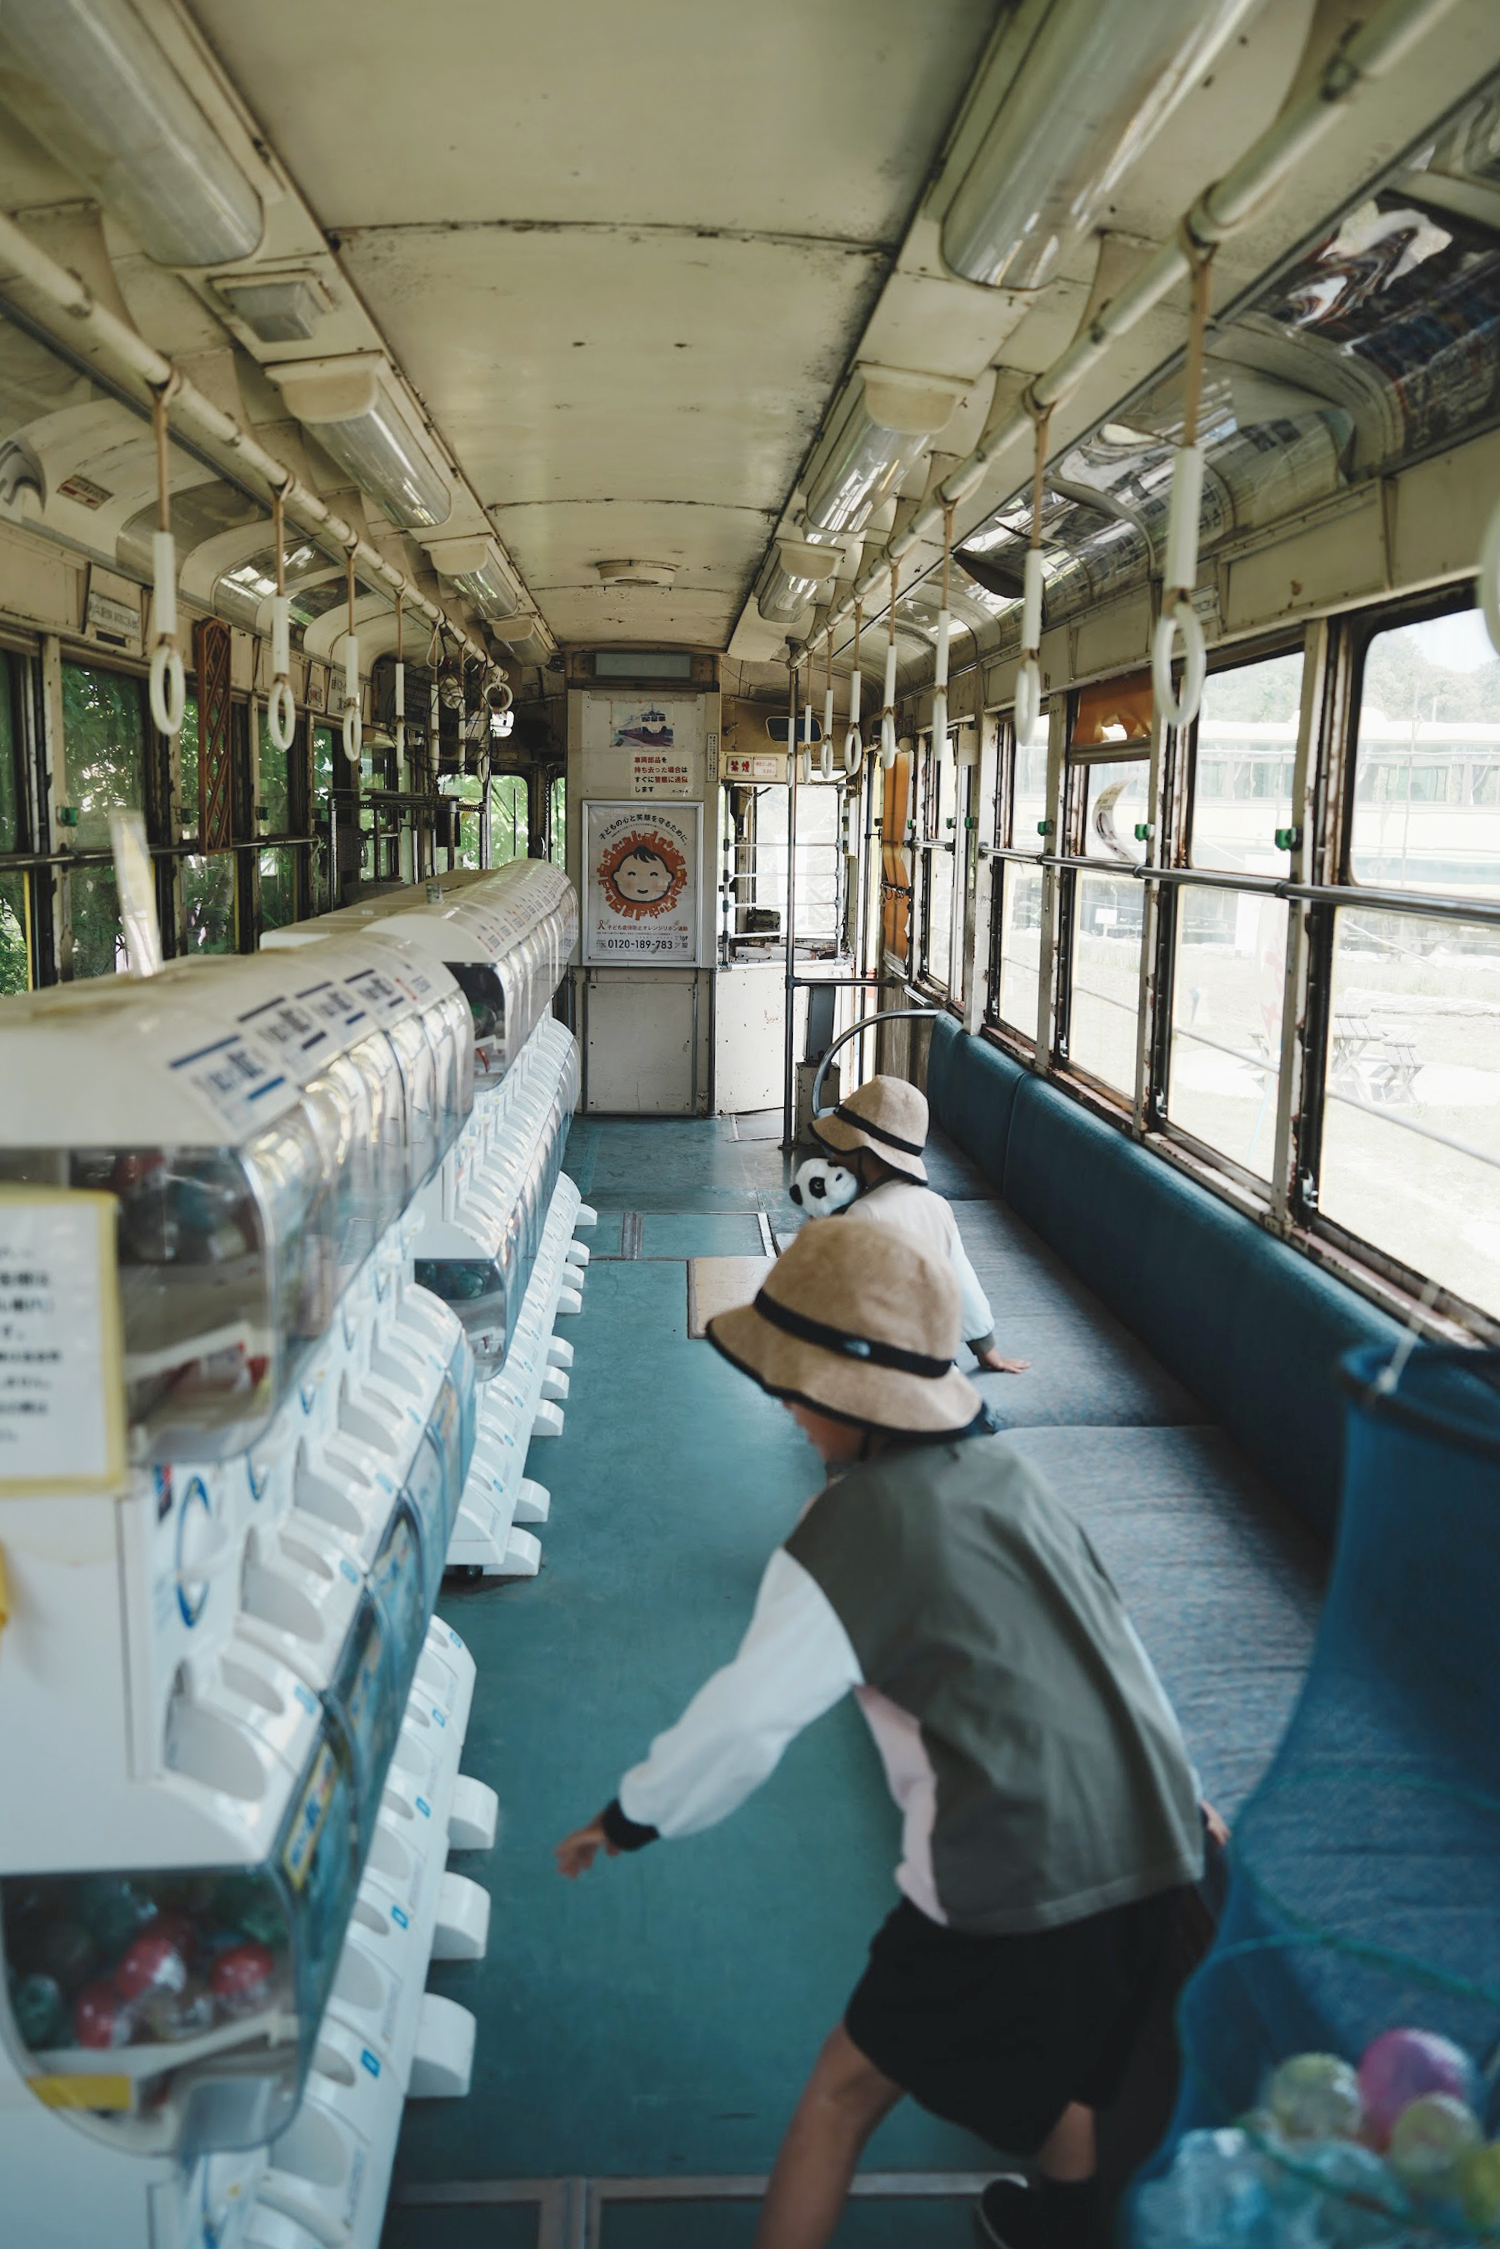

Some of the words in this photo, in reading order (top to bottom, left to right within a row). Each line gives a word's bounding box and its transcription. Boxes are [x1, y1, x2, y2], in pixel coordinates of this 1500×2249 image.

[634, 766, 688, 774] 持ち去った場合は
[730, 760, 750, 772] 禁煙
[608, 939, 673, 949] 0120-189-783
